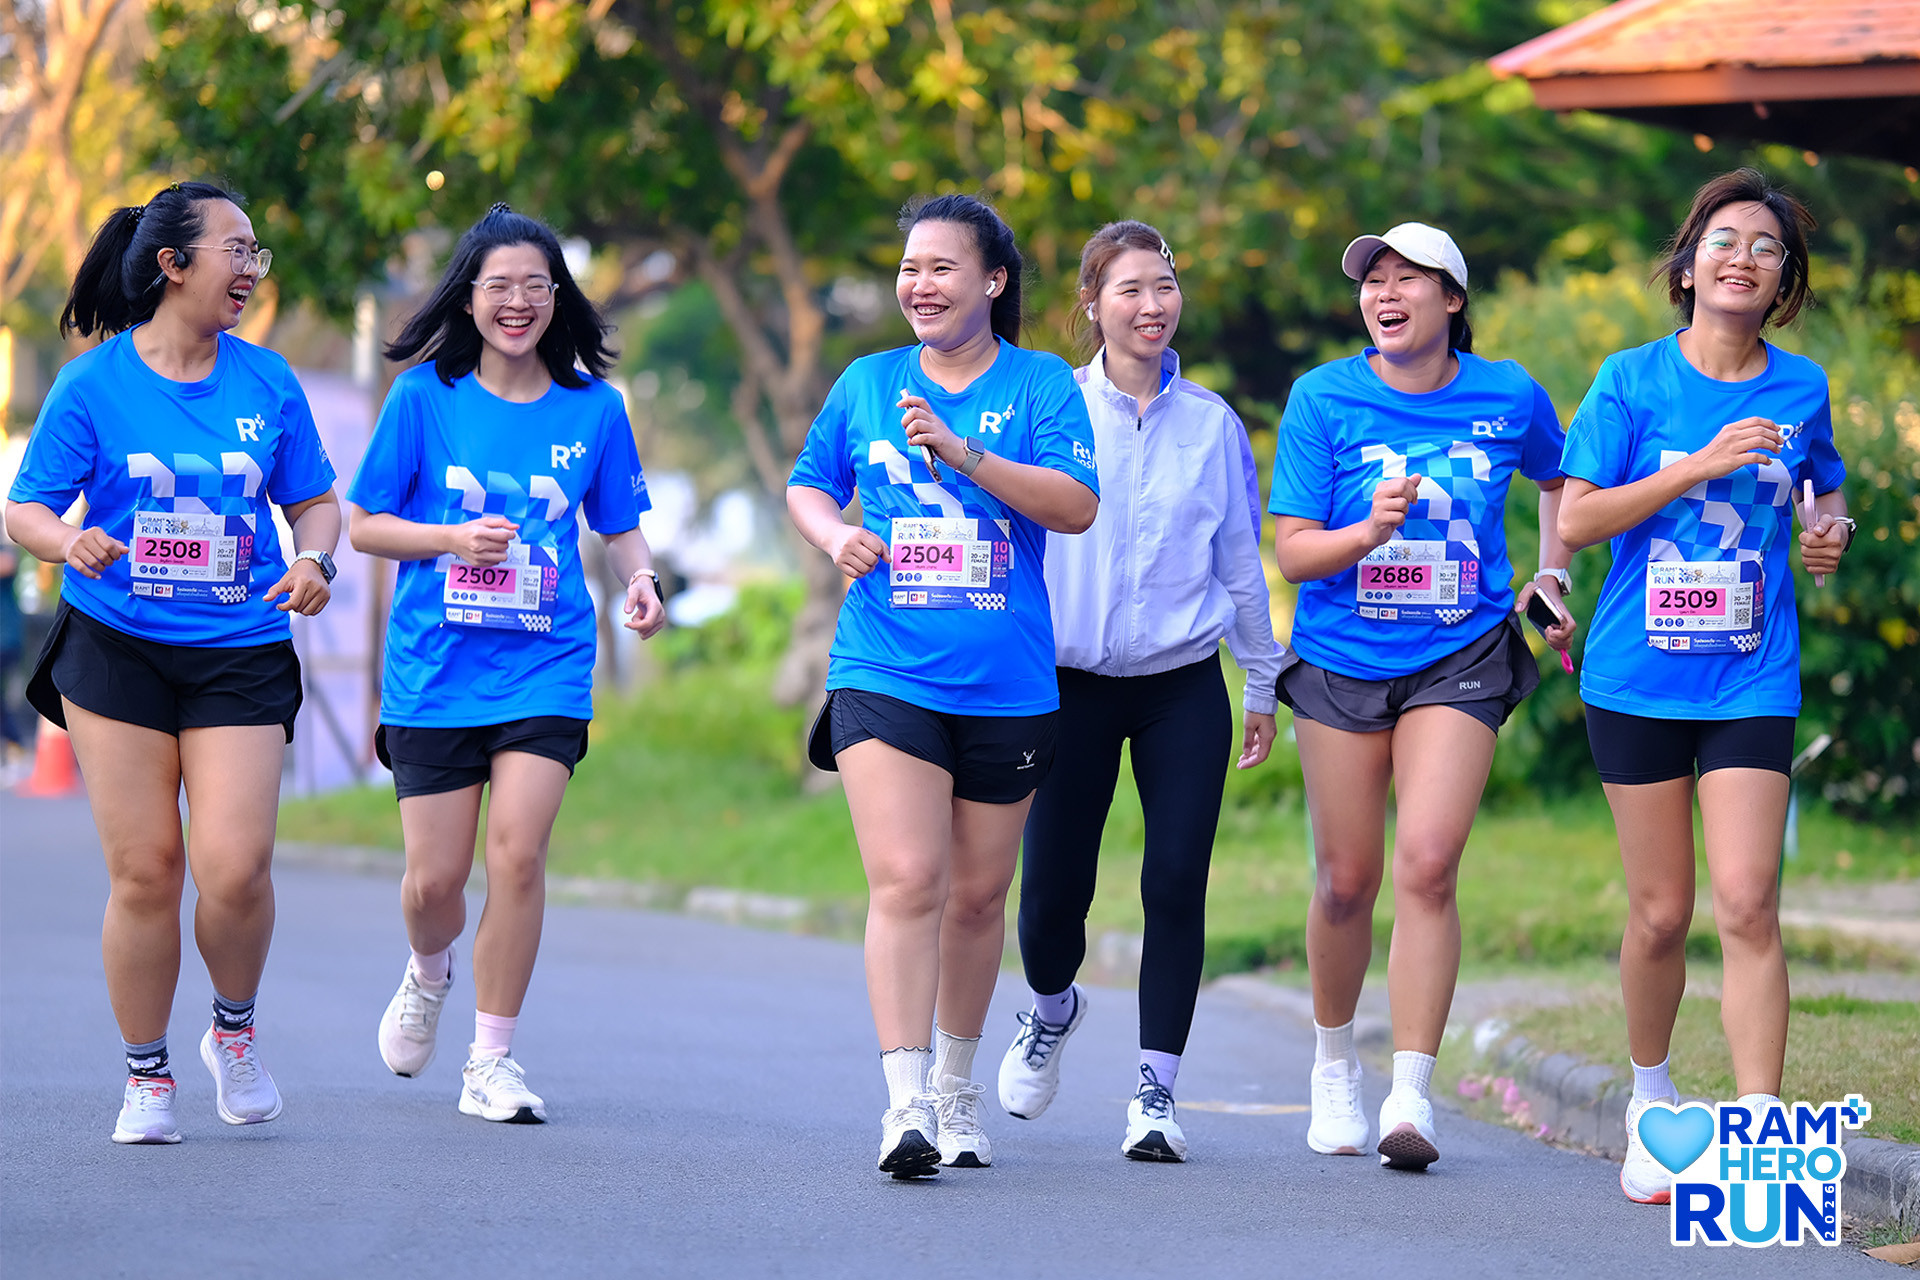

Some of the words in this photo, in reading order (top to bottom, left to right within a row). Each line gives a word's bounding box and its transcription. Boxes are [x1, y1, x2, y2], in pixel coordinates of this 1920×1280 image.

[141, 526, 161, 534] RUN
[239, 536, 253, 547] 10
[898, 532, 915, 540] RUN
[144, 540, 201, 559] 2508
[239, 548, 252, 557] KM
[993, 541, 1008, 553] 10
[900, 546, 954, 564] 2504
[994, 554, 1008, 562] KM
[1461, 560, 1478, 572] 10
[457, 566, 510, 586] 2507
[543, 567, 558, 578] 10
[1370, 567, 1423, 584] 2686
[1461, 573, 1477, 581] KM
[543, 580, 557, 588] KM
[1654, 576, 1675, 584] RUN
[1659, 590, 1718, 608] 2509
[1459, 681, 1480, 690] RUN
